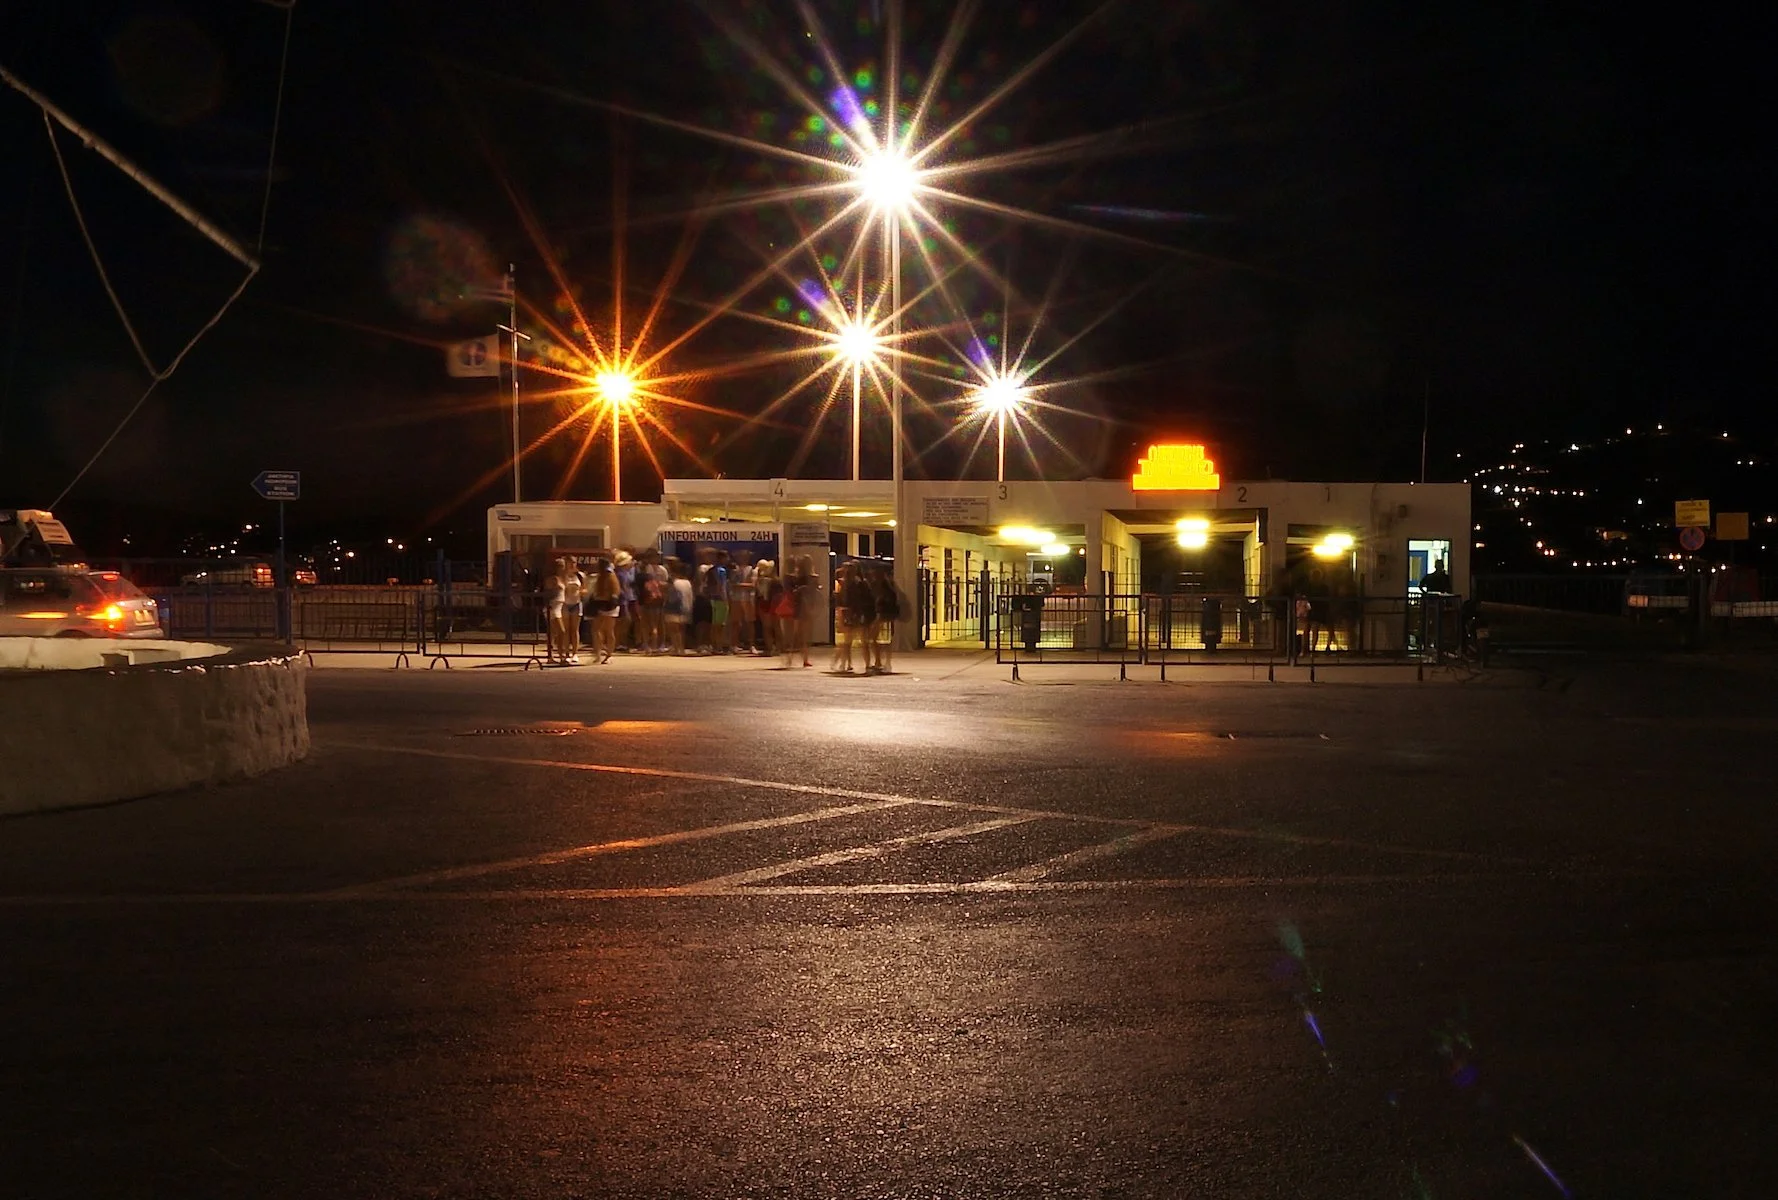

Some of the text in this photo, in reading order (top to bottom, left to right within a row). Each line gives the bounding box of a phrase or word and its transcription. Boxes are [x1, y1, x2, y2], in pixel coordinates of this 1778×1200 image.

[774, 482, 783, 497] 4
[998, 484, 1007, 500] 3
[1237, 486, 1248, 503] 2
[1324, 487, 1331, 503] 1
[664, 531, 770, 541] INFORMATION 24H
